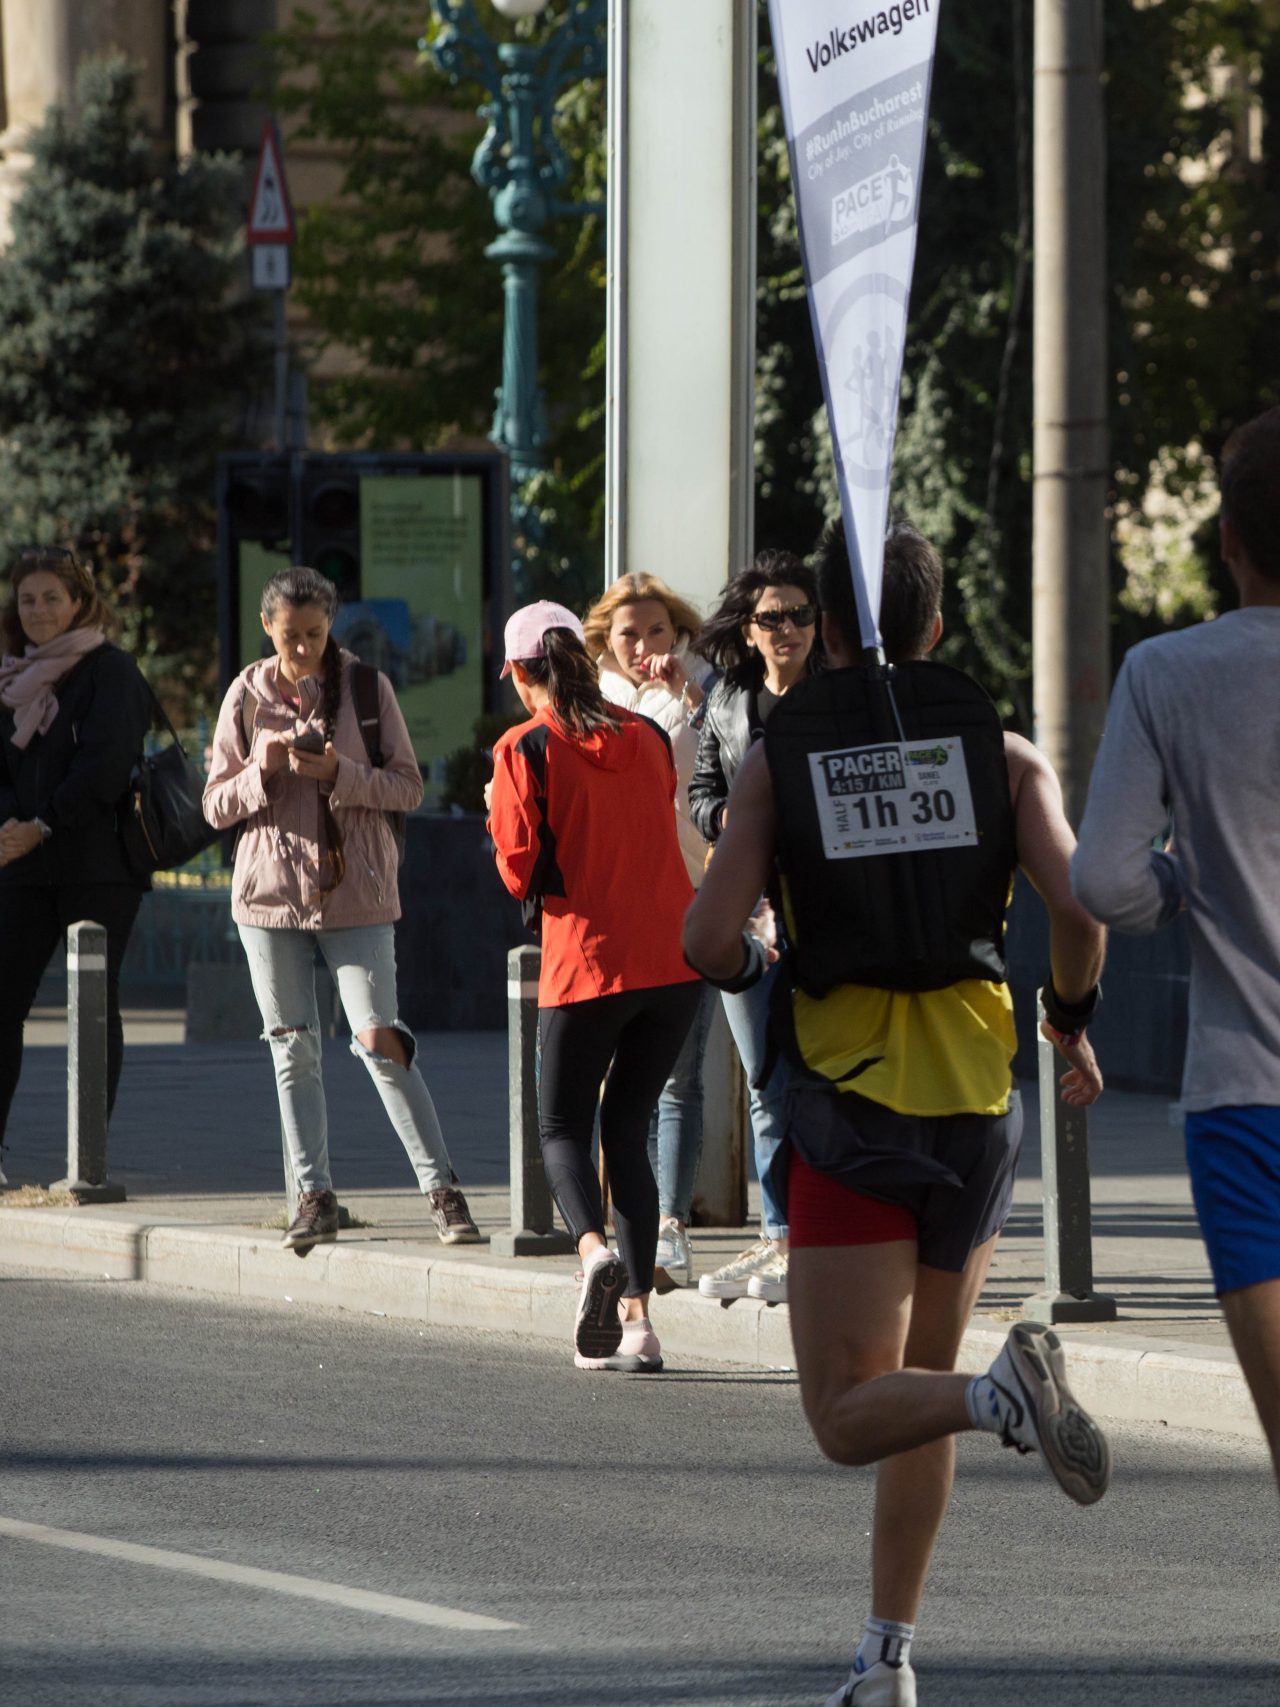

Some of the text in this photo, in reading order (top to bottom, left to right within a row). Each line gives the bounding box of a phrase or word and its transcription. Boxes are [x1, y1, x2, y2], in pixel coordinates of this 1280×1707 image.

[806, 0, 930, 73] Volkswagen
[805, 81, 922, 161] #RunInBucharest
[853, 133, 873, 150] City
[836, 175, 882, 224] PACE
[828, 750, 902, 778] PACER
[831, 777, 864, 794] 4:15
[878, 774, 904, 789] KM
[833, 800, 849, 833] HALF
[909, 789, 956, 825] 30
